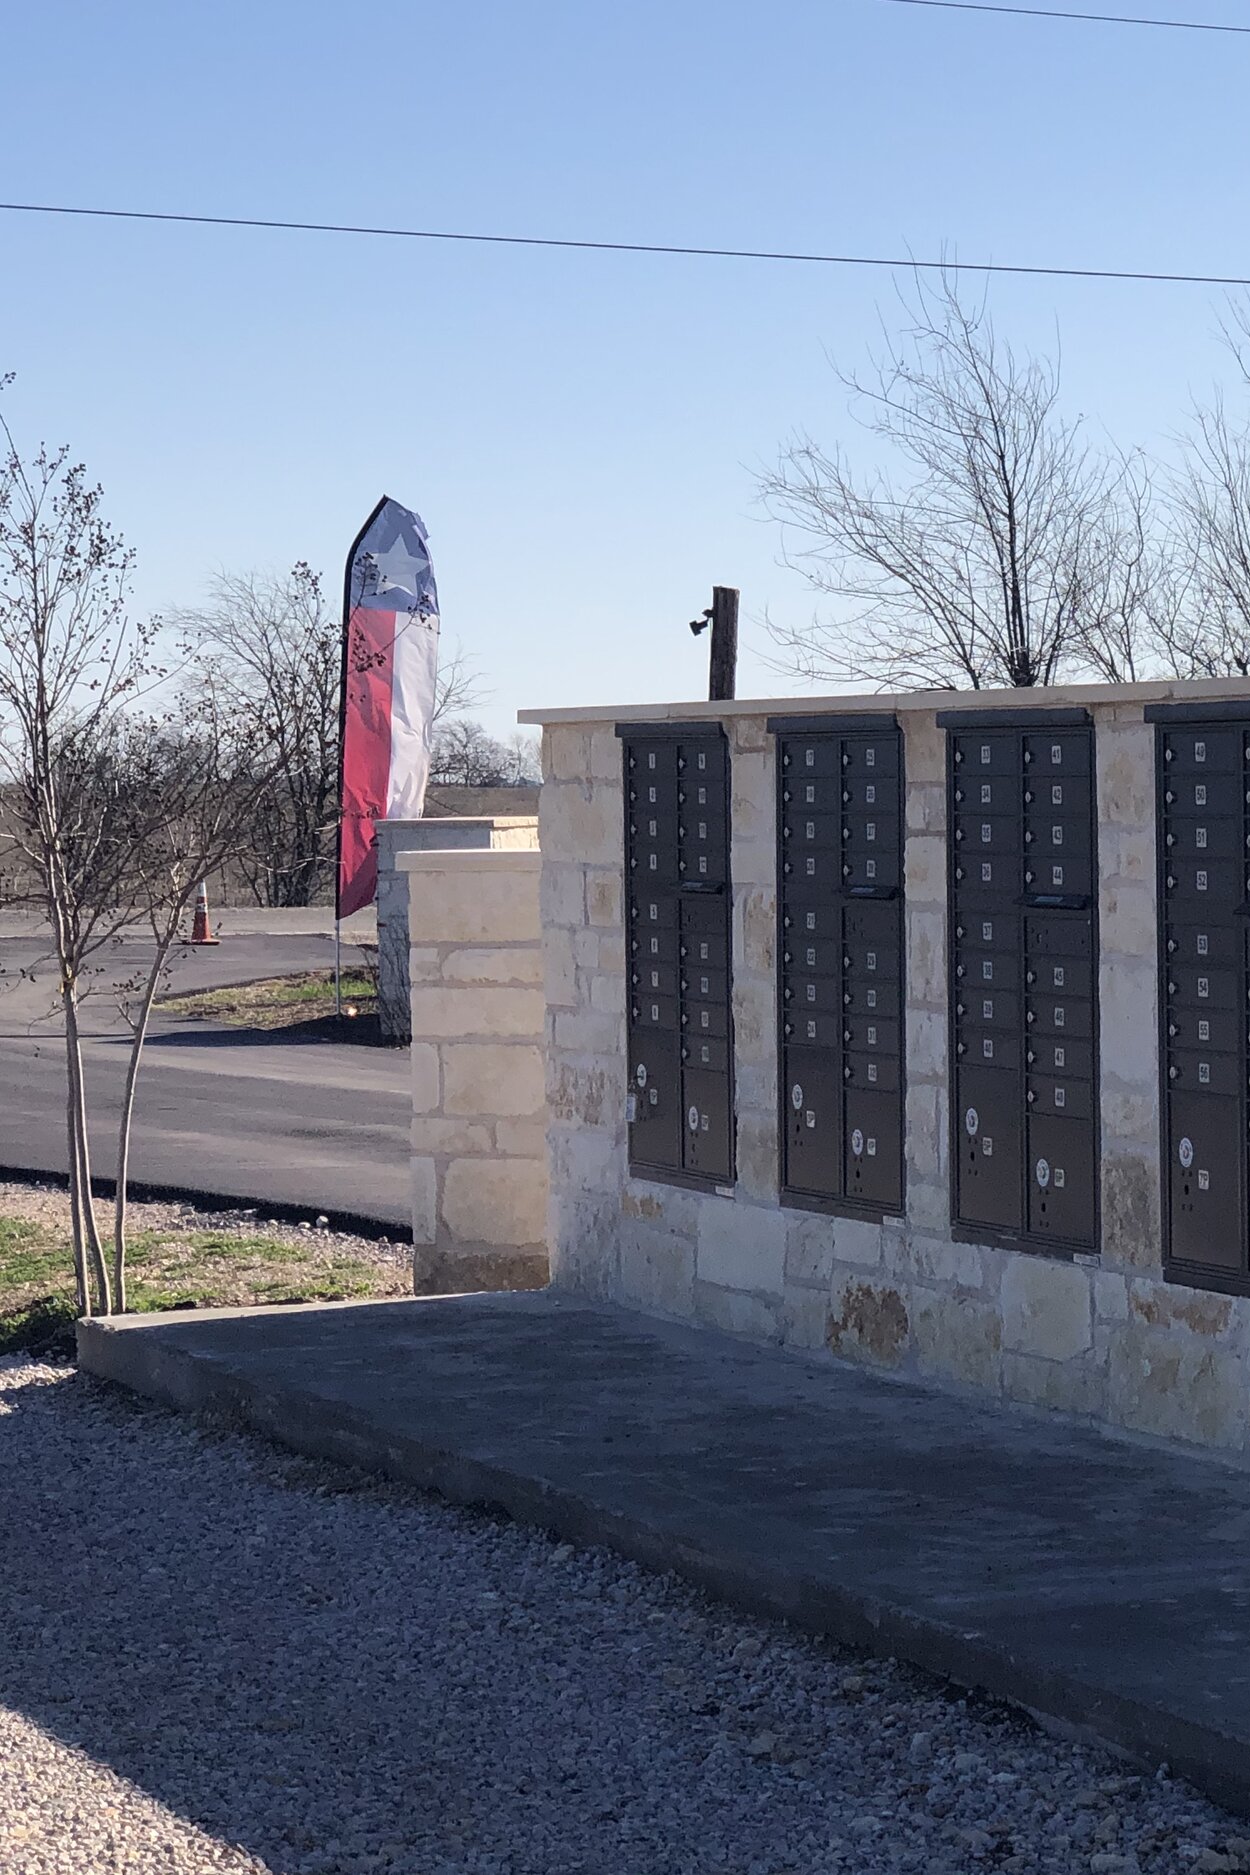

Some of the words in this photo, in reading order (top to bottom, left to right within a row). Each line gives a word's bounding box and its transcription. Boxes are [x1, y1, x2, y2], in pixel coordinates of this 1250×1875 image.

[1196, 745, 1204, 758] 49
[1196, 787, 1206, 801] 50
[1196, 830, 1206, 844] 51
[1198, 873, 1206, 887] 52
[1198, 937, 1206, 951] 53
[1198, 980, 1208, 994] 54
[1200, 1023, 1208, 1037] 55
[1200, 1065, 1208, 1079] 56
